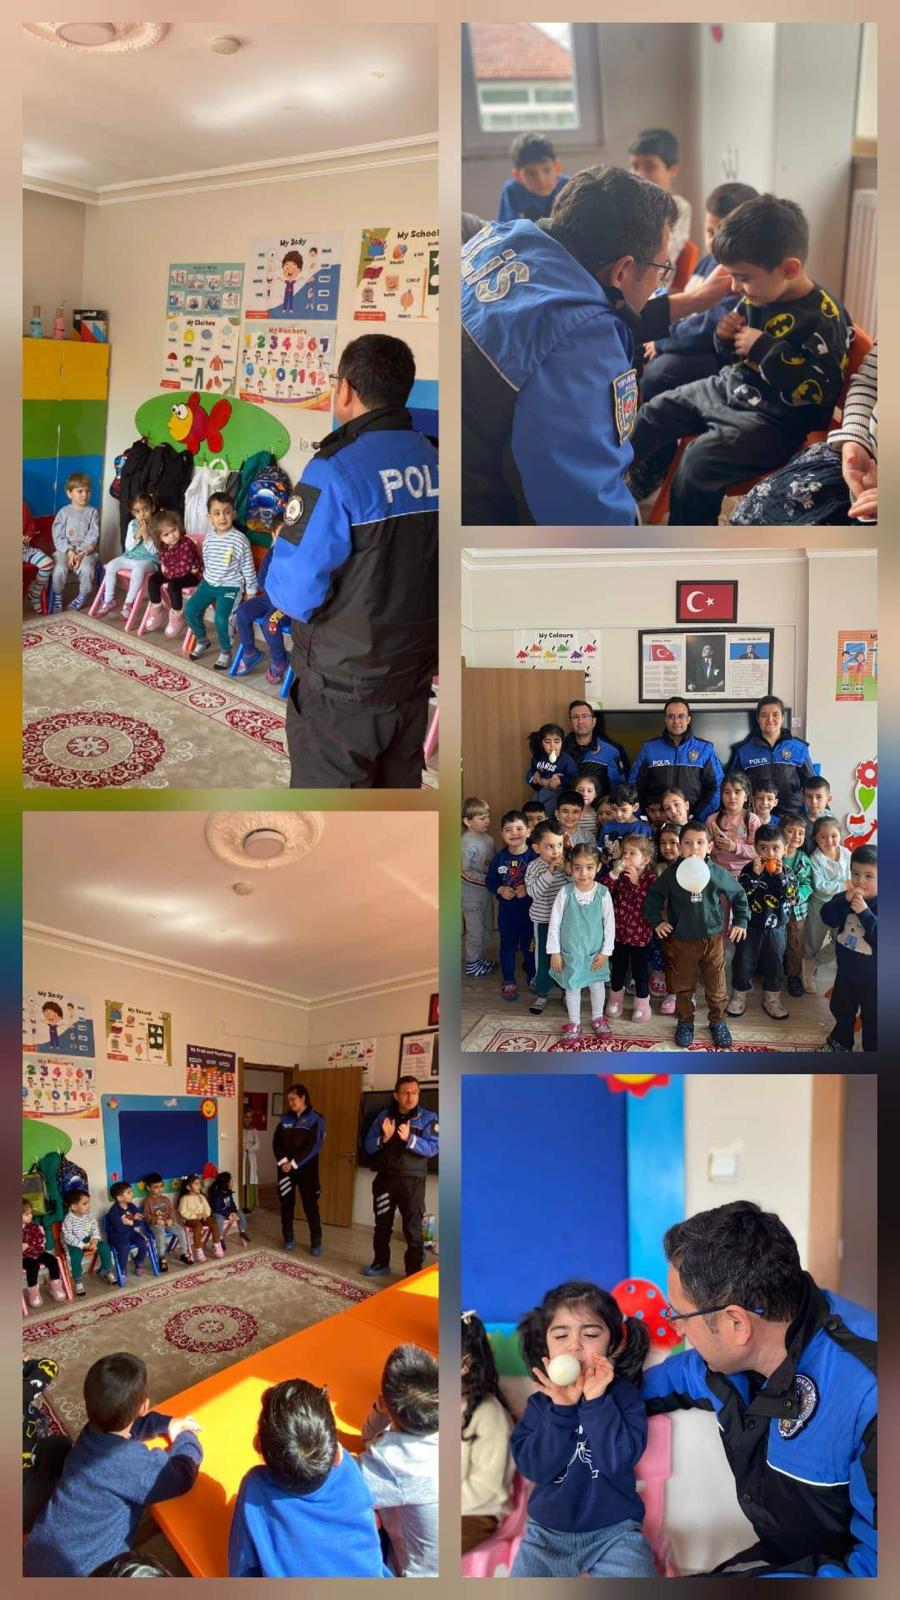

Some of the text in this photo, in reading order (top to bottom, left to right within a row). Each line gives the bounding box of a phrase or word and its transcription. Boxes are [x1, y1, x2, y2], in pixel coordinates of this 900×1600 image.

[290, 238, 307, 247] Body
[396, 229, 439, 240] My School
[257, 335, 266, 349] 2
[269, 335, 278, 350] 3
[282, 337, 291, 351] 4
[307, 337, 317, 352] 6
[319, 338, 329, 353] 7
[270, 367, 286, 382] 10
[289, 368, 306, 384] 11
[308, 371, 326, 385] 12
[27, 1064, 36, 1075] 2
[40, 1065, 49, 1077] 3
[52, 1066, 62, 1077] 4
[76, 1068, 84, 1079] 6
[85, 1069, 93, 1080] 7
